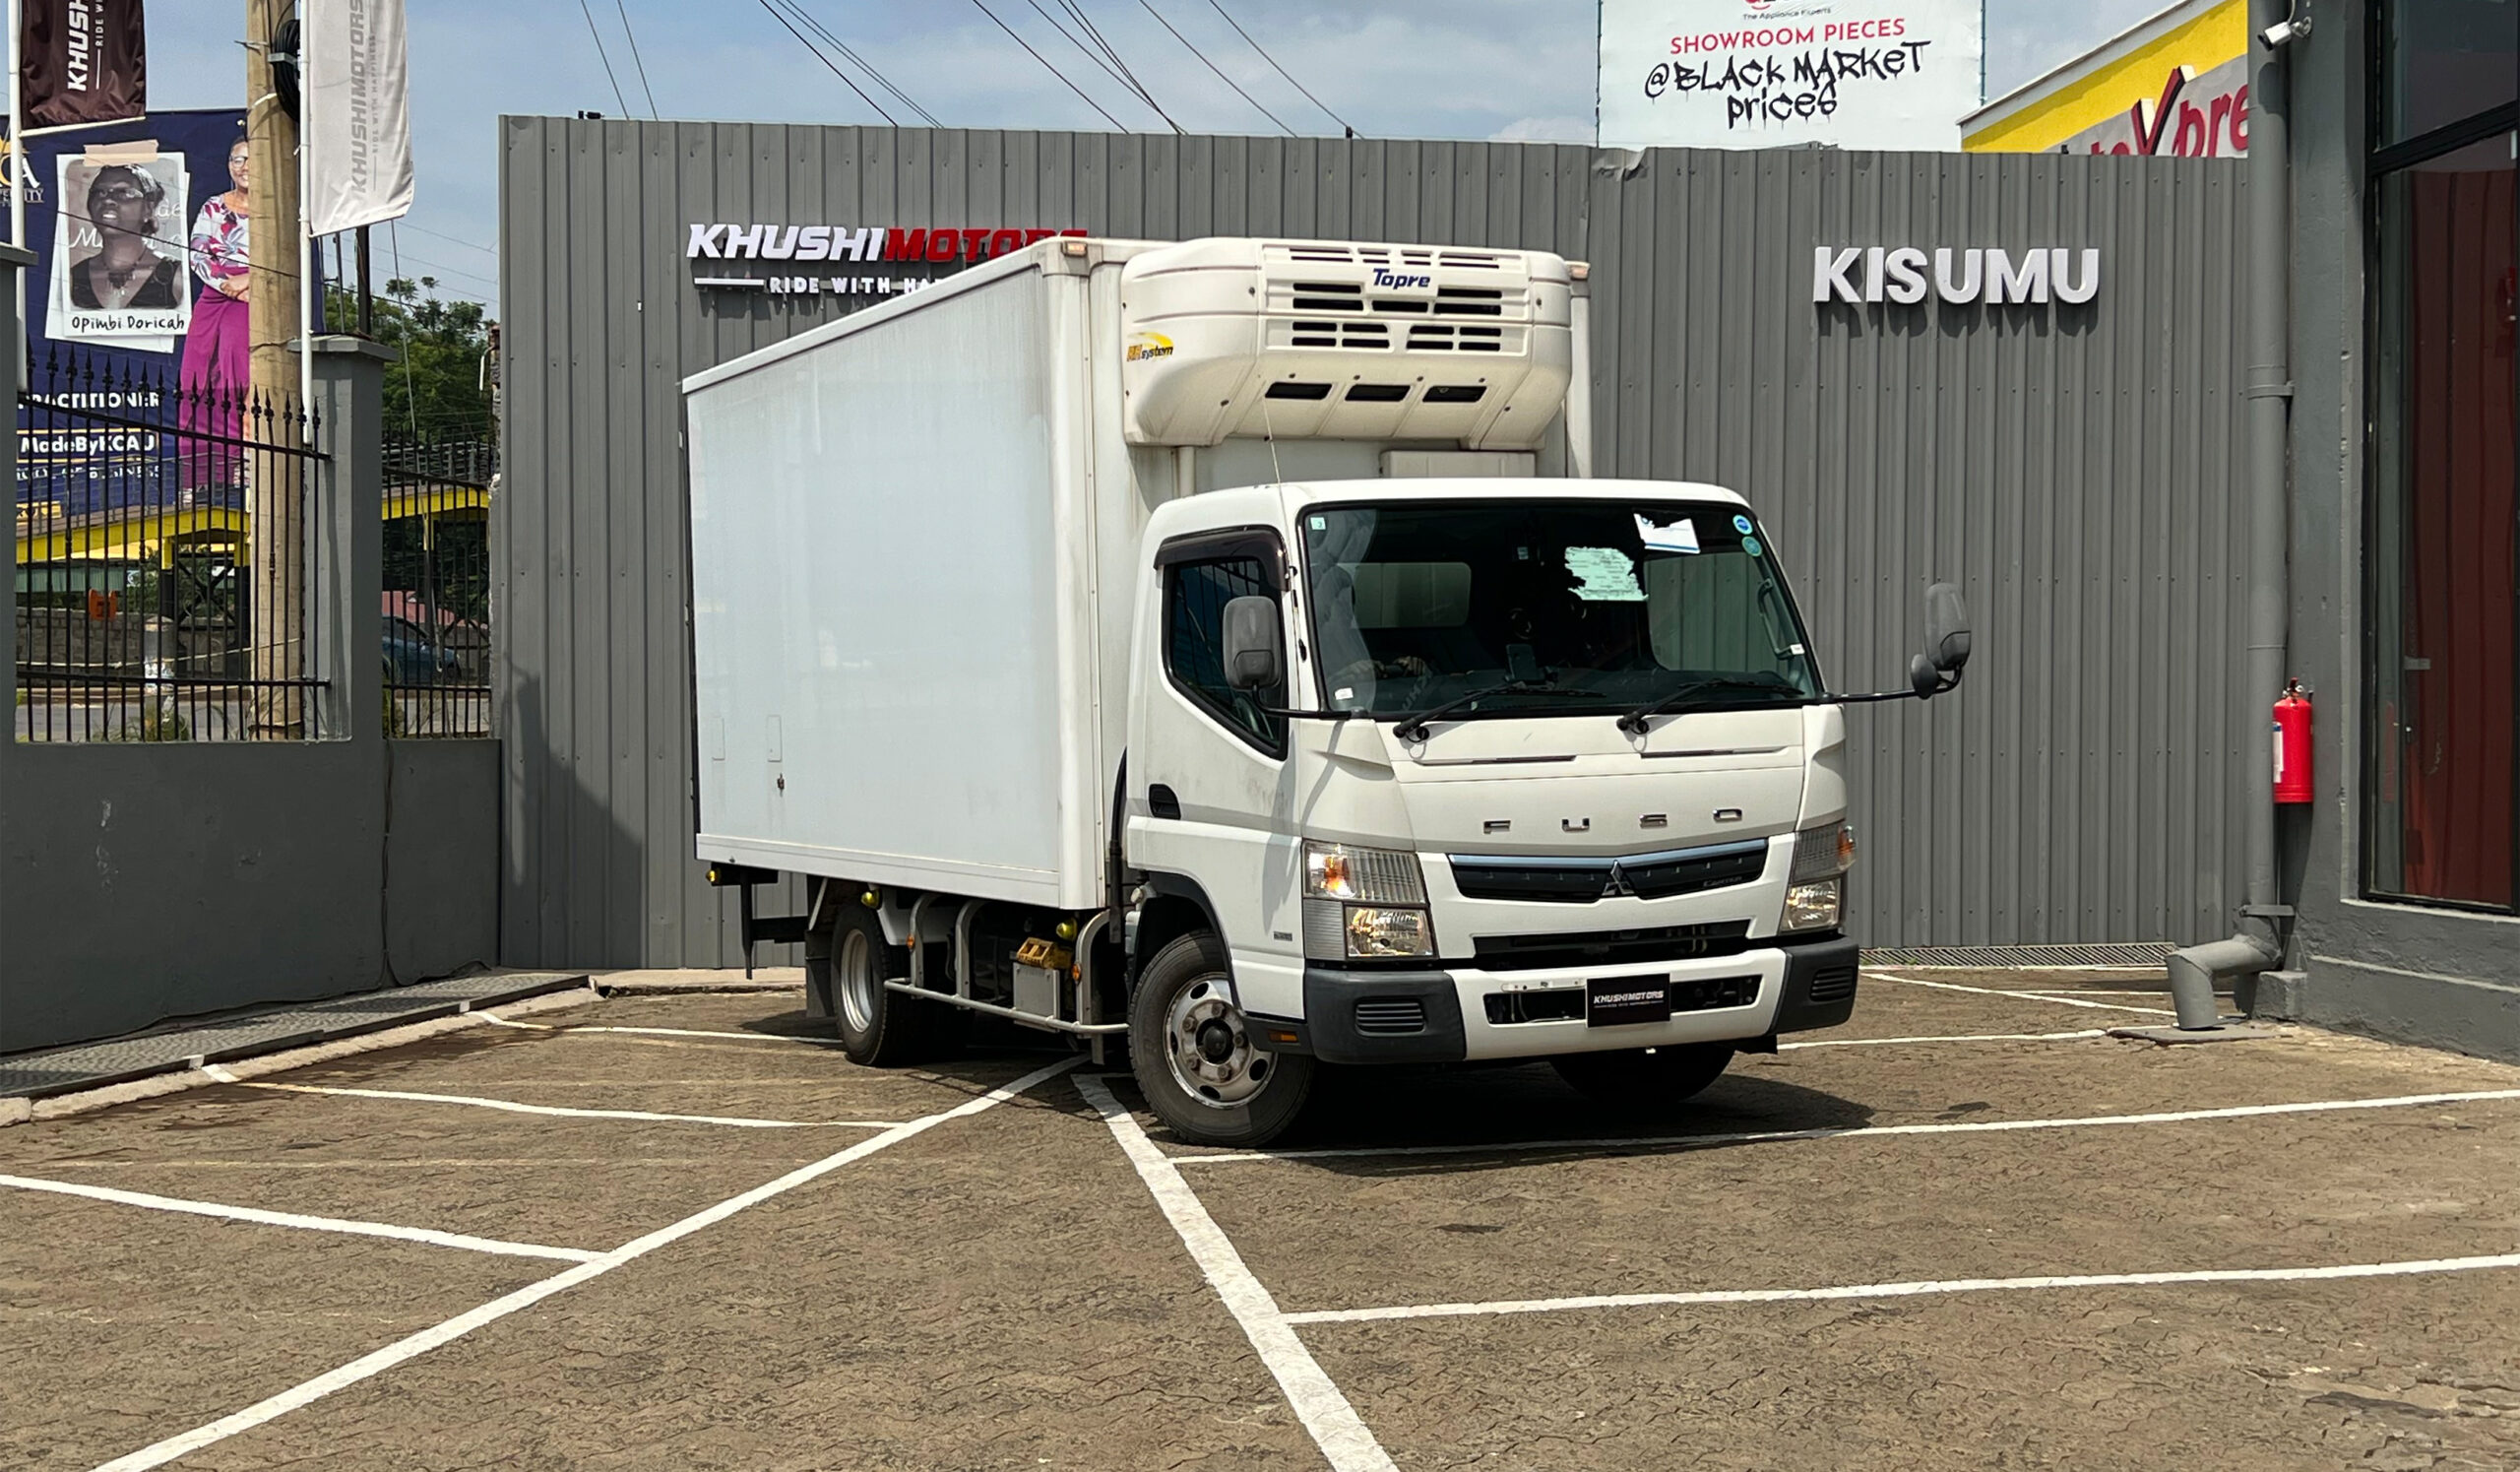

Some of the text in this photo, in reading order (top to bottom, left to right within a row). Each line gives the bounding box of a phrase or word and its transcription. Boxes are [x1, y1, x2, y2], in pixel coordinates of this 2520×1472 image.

[95, 18, 104, 47] RIDE
[1670, 18, 1906, 55] SHOWROOM PIECES
[349, 0, 367, 193] KHUSHIMOTORS
[1727, 83, 1838, 130] prices
[769, 277, 819, 294] RIDE
[831, 277, 891, 294] WITH
[1372, 268, 1431, 290] Topre
[1812, 246, 2100, 304] KISUMU
[72, 313, 185, 333] Opimbi Doricah
[1483, 808, 1742, 835] FUSO
[1594, 991, 1665, 1004] KHUSHIMOTORS
